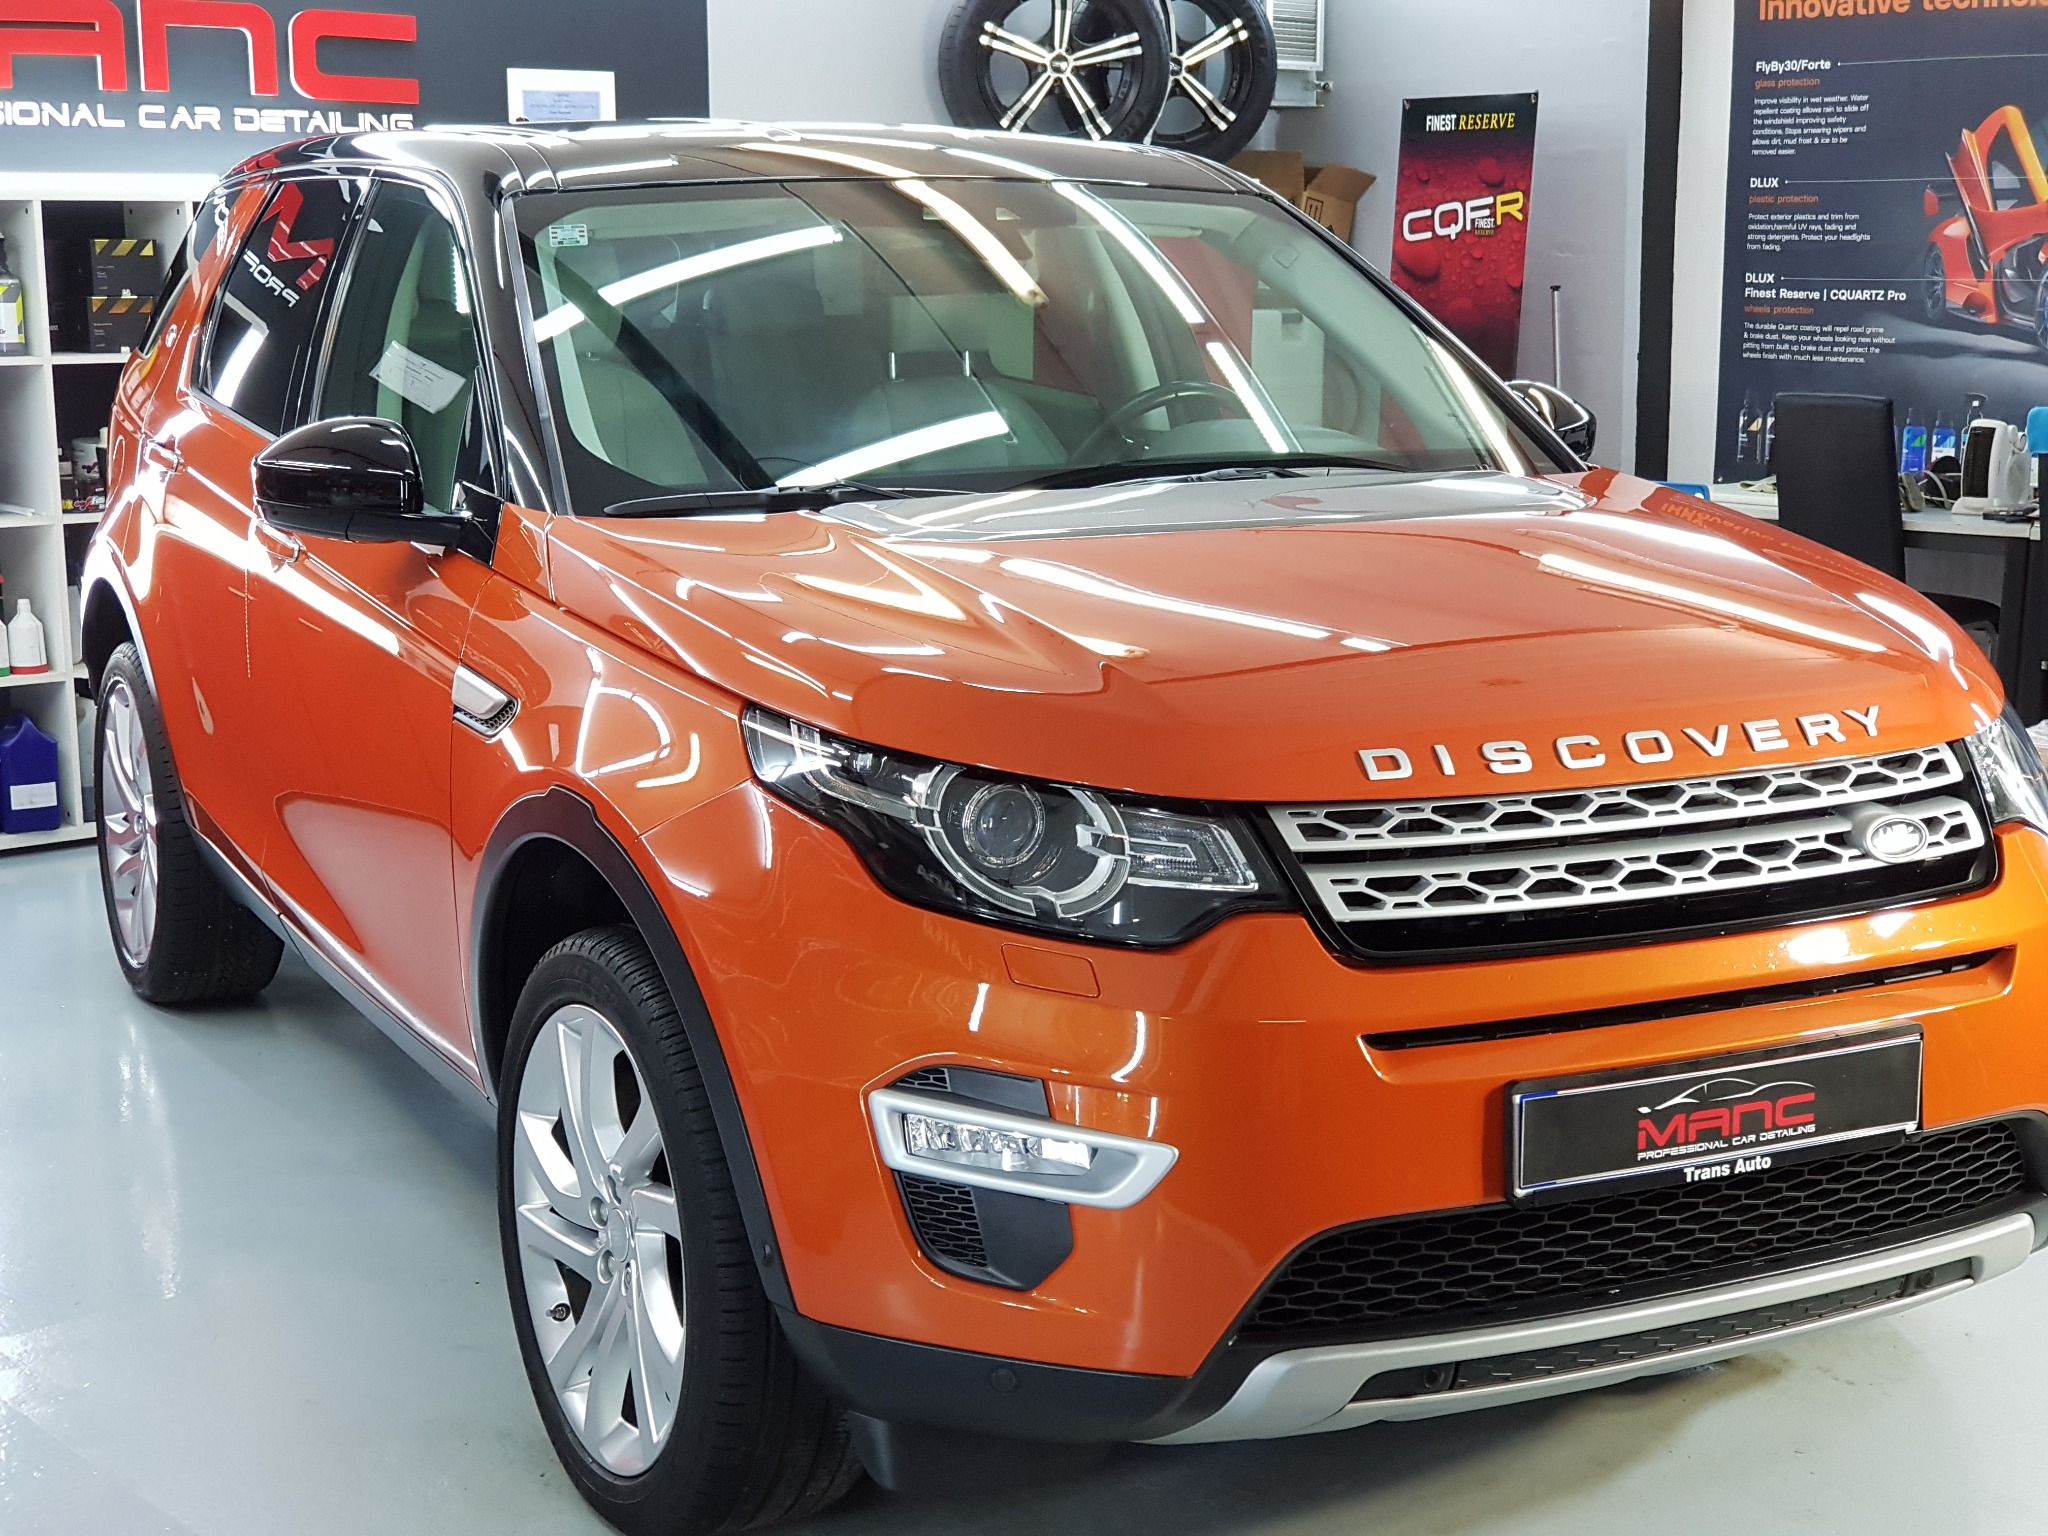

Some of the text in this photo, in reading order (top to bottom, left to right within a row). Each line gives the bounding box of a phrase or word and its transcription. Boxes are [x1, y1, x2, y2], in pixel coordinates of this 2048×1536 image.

[1755, 60, 1831, 74] FlyBy30/Forte
[1754, 78, 1820, 90] glass protection
[1754, 97, 1778, 106] Improve
[1780, 96, 1801, 105] visibility
[1823, 94, 1848, 102] weather.
[1850, 94, 1869, 102] Water
[1753, 108, 1778, 116] repellent
[1780, 107, 1800, 116] coating
[1802, 106, 1822, 114] allows
[1844, 104, 1858, 112] slide
[1860, 104, 1870, 112] off
[138, 104, 221, 131] CAR
[233, 107, 414, 134] DETAILING
[1426, 112, 1516, 132] FINEST RESERVE
[1753, 116, 1847, 126] the windshield improving safety
[1784, 127, 1802, 136] Stops
[1803, 126, 1831, 136] smearing
[1833, 126, 1852, 134] wipers
[1854, 124, 1866, 132] and
[1752, 138, 1770, 146] allows
[1799, 136, 1812, 144] frost
[1820, 136, 1830, 144] ice
[1832, 136, 1838, 144] to
[1840, 136, 1848, 144] be
[1752, 148, 1777, 156] removed
[1750, 177, 1779, 188] DLUX
[1749, 194, 1818, 205] plastic protection
[1402, 191, 1524, 242] CQFR
[1770, 212, 1792, 220] exterior
[1794, 212, 1816, 222] plastics
[1818, 212, 1829, 220] and
[1830, 212, 1843, 220] trim
[1844, 212, 1860, 220] from
[1809, 224, 1822, 232] rays,
[1824, 222, 1843, 232] fading
[1844, 222, 1856, 230] and
[1747, 232, 1766, 242] strong
[1767, 232, 1800, 242] detergents.
[1824, 234, 1838, 242] your
[1840, 232, 1870, 242] headlights
[1746, 242, 1782, 252] from fading.
[1745, 272, 1774, 284] DLUX
[1744, 287, 1776, 298] Finest
[1779, 288, 1820, 300] Reserve
[1830, 290, 1884, 300] CQUARTZ
[1887, 290, 1906, 300] Pro
[1744, 304, 1814, 316] wheels protection
[1800, 324, 1820, 333] coating
[1822, 324, 1832, 332] will
[1834, 326, 1849, 334] repel
[1765, 332, 1780, 340] dust.
[1782, 334, 1797, 342] Keep
[1834, 335, 1856, 344] looking
[1872, 336, 1896, 344] without
[1743, 342, 1760, 350] pitting
[1761, 342, 1774, 350] from
[1776, 342, 1790, 350] built
[1790, 344, 1799, 352] up
[1846, 346, 1868, 354] protect
[1870, 346, 1880, 354] the
[1812, 354, 1824, 362] less
[1357, 705, 1881, 782] DISCOVERY
[1637, 1092, 1816, 1150] MANC
[1637, 1124, 1816, 1161] PROFESSIONAL CAR DETAILING
[1684, 1156, 1772, 1183] Trans Auto
